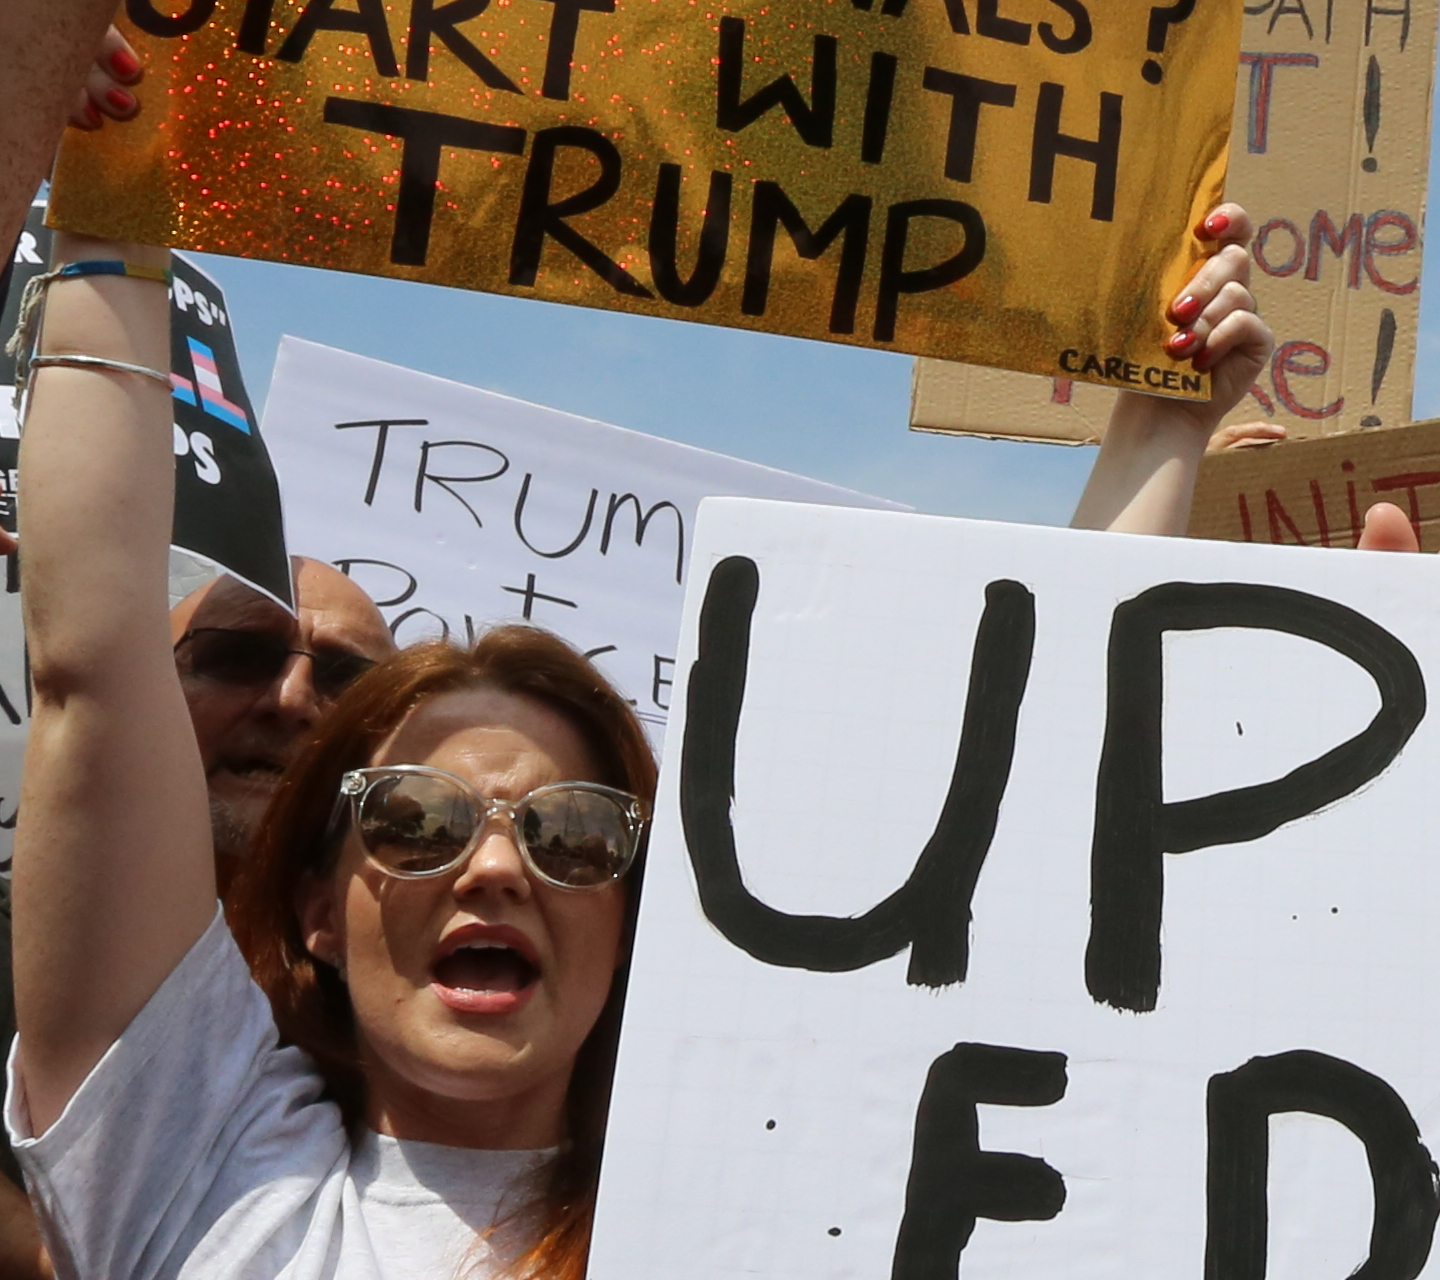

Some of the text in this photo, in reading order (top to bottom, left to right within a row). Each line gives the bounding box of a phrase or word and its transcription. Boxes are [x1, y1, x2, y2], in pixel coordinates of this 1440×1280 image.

[324, 95, 986, 343] TRUMP
[715, 15, 1123, 222] WITH
[1059, 349, 1201, 393] CARECEN
[679, 554, 1425, 1014] UP
